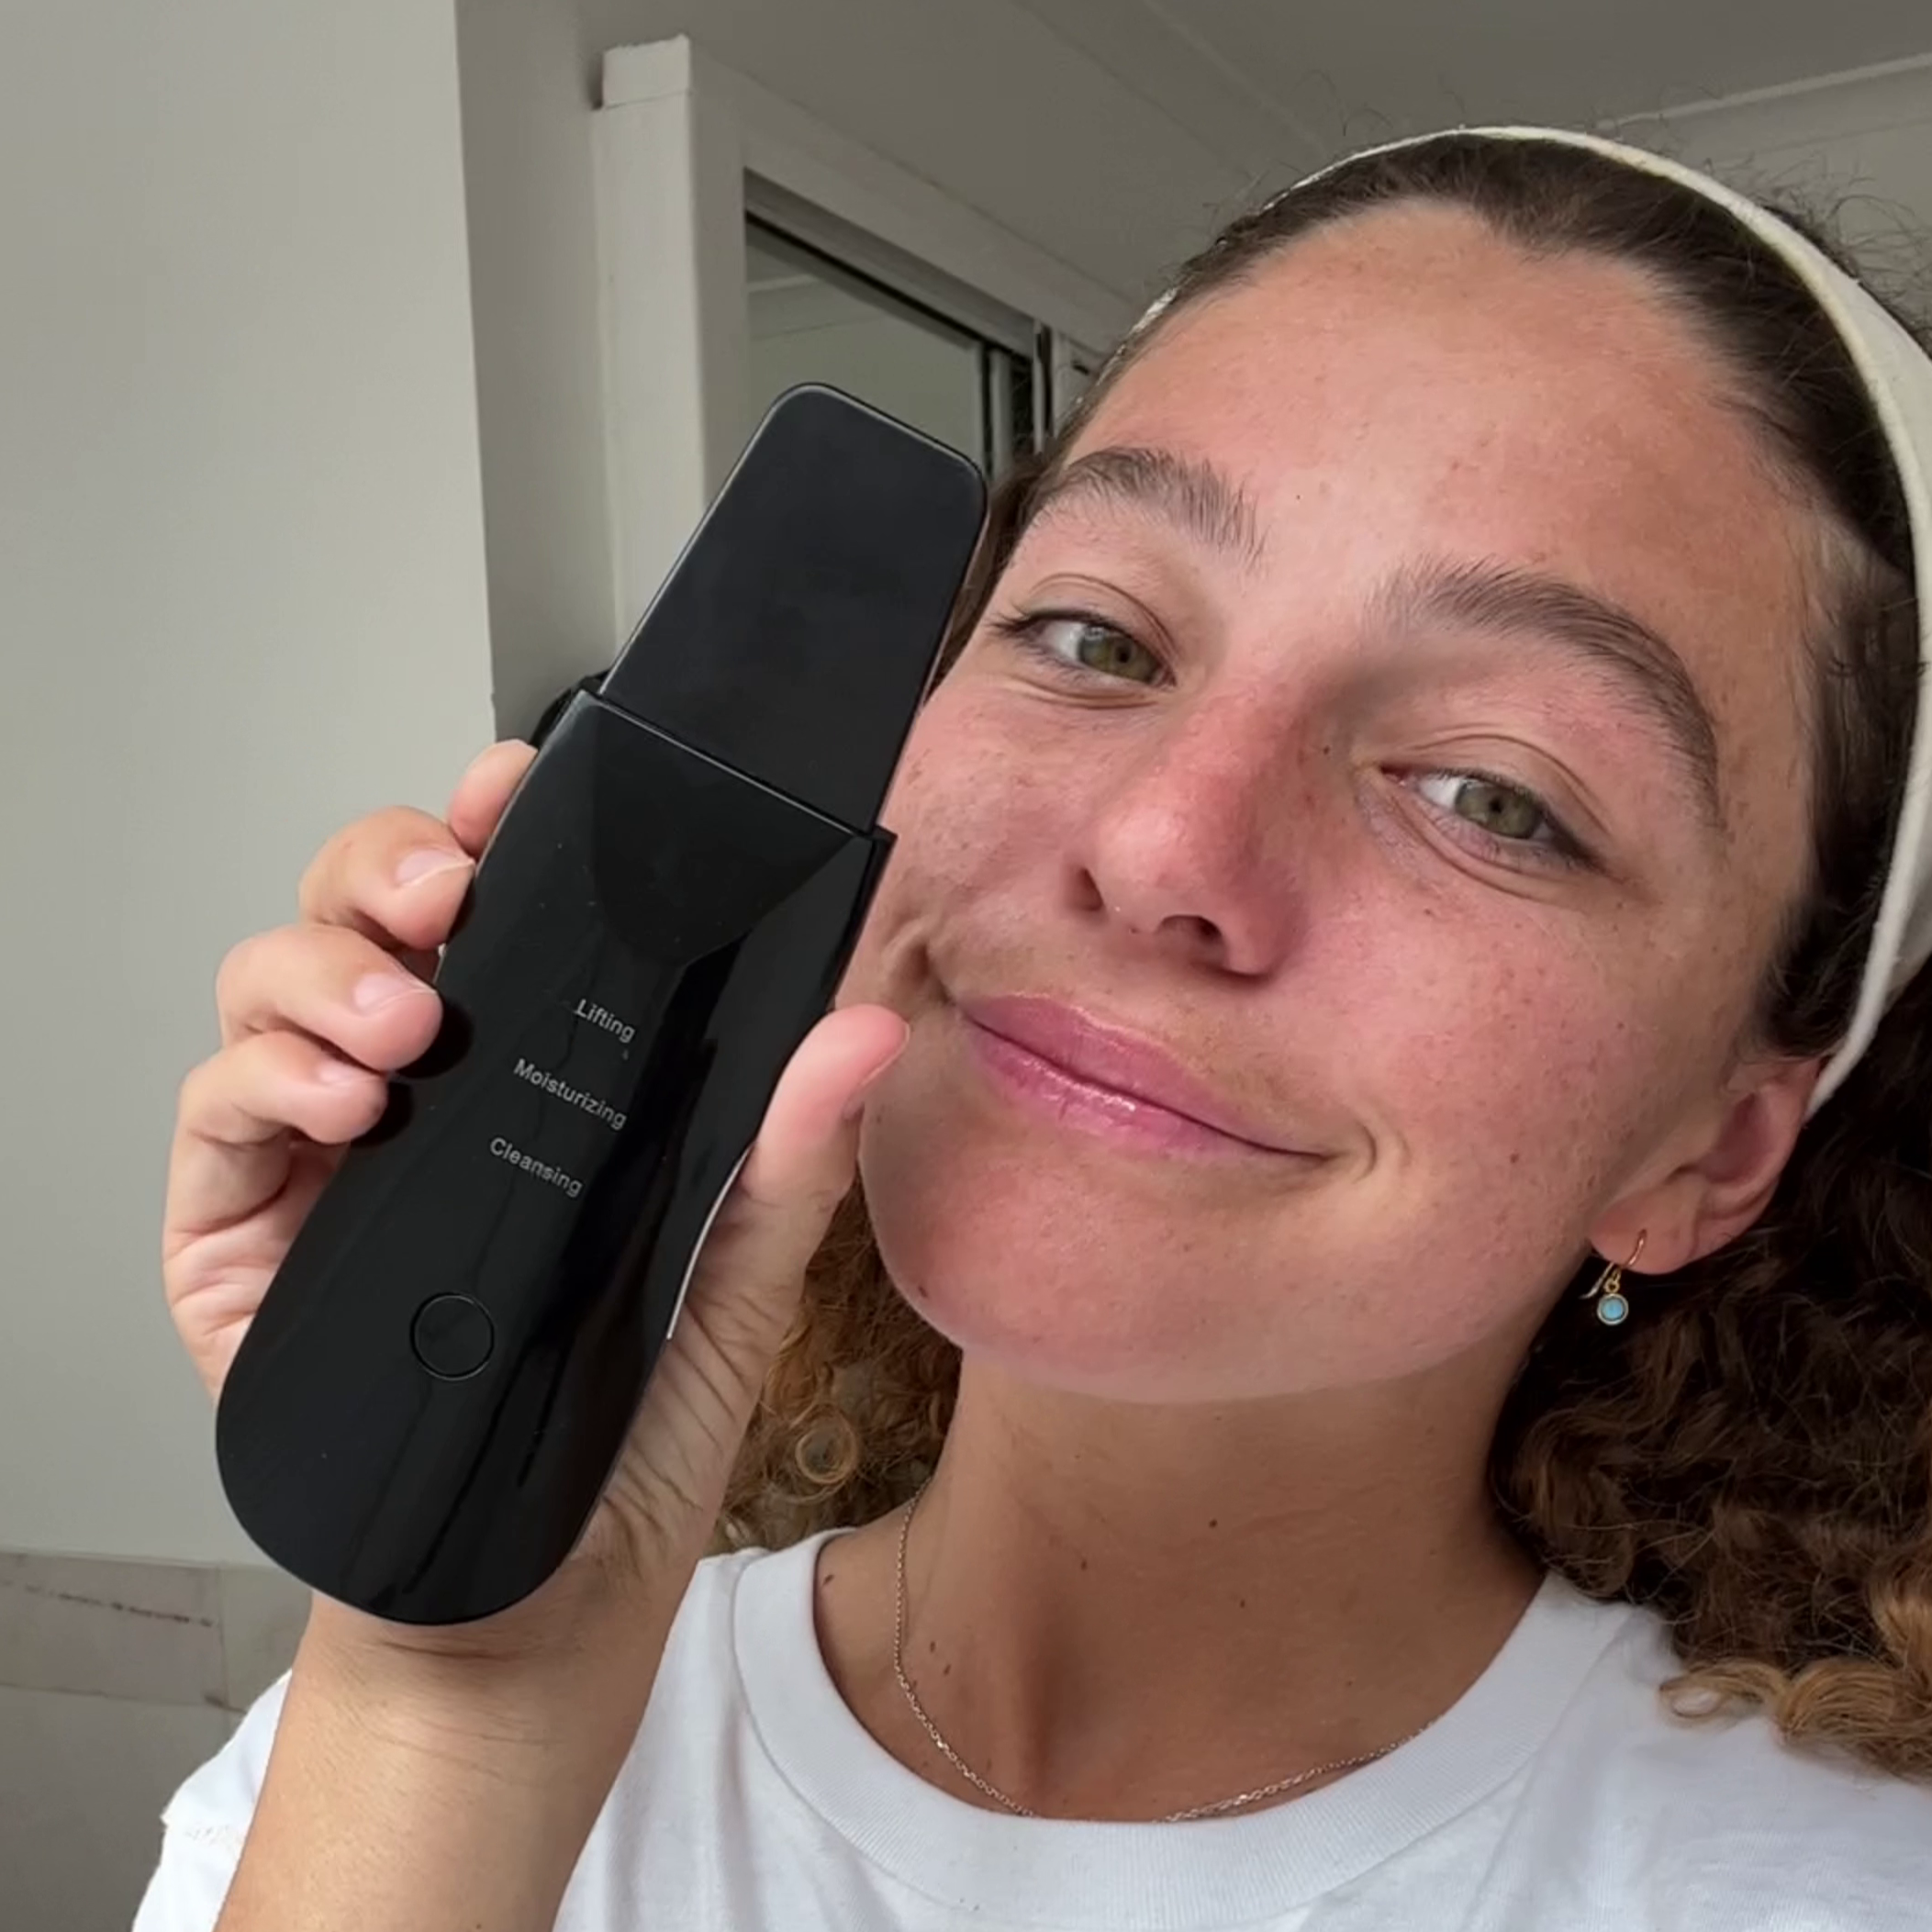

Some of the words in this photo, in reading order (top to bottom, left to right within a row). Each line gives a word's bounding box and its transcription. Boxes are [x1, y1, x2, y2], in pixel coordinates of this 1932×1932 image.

[574, 998, 636, 1044] Lifting
[513, 1057, 628, 1131] Moisturizing
[489, 1136, 583, 1198] Cleansing
